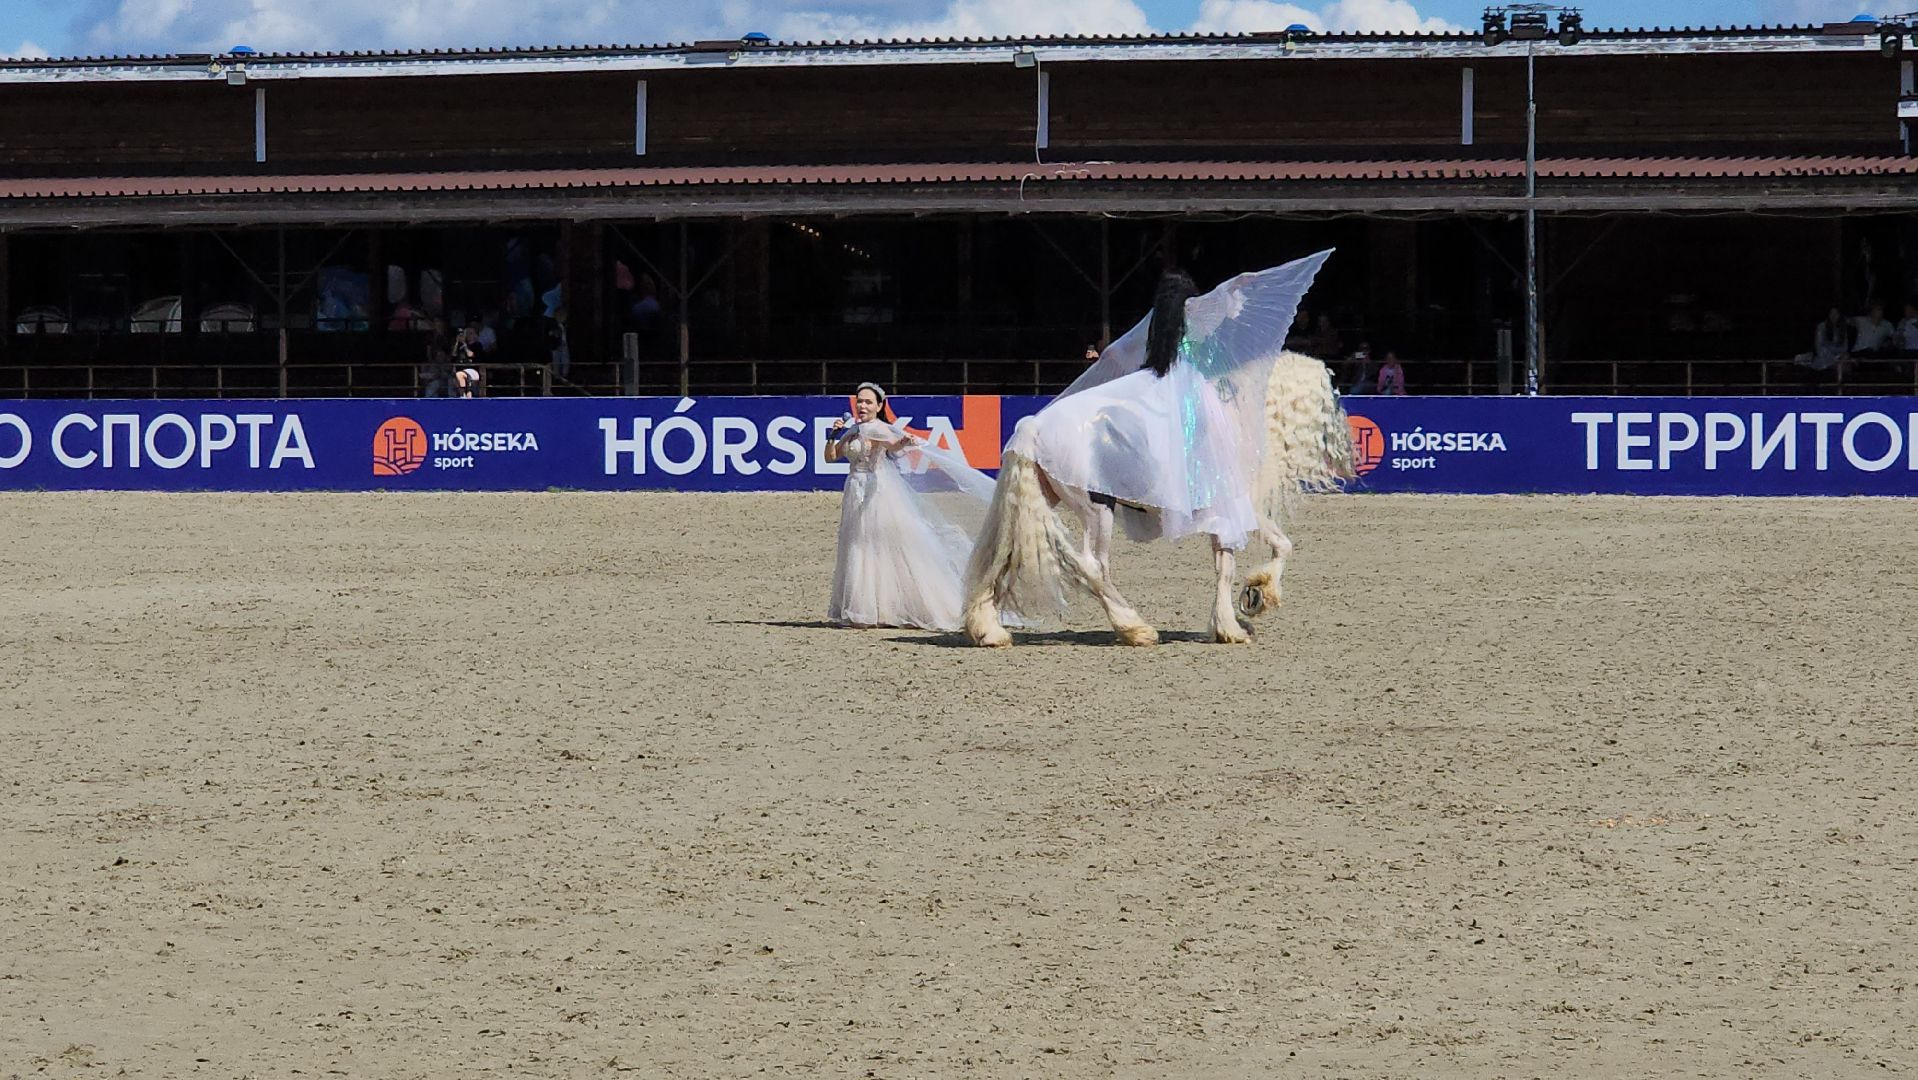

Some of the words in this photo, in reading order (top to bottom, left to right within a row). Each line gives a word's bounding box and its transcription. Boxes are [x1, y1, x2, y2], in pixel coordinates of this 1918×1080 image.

[51, 413, 316, 468] СПОРТА
[432, 427, 539, 451] HÓRSEKA
[1390, 426, 1507, 451] HÓRSEKA
[1571, 411, 1918, 472] ТЕРРИТО
[433, 456, 474, 470] sport
[1391, 456, 1436, 471] sport
